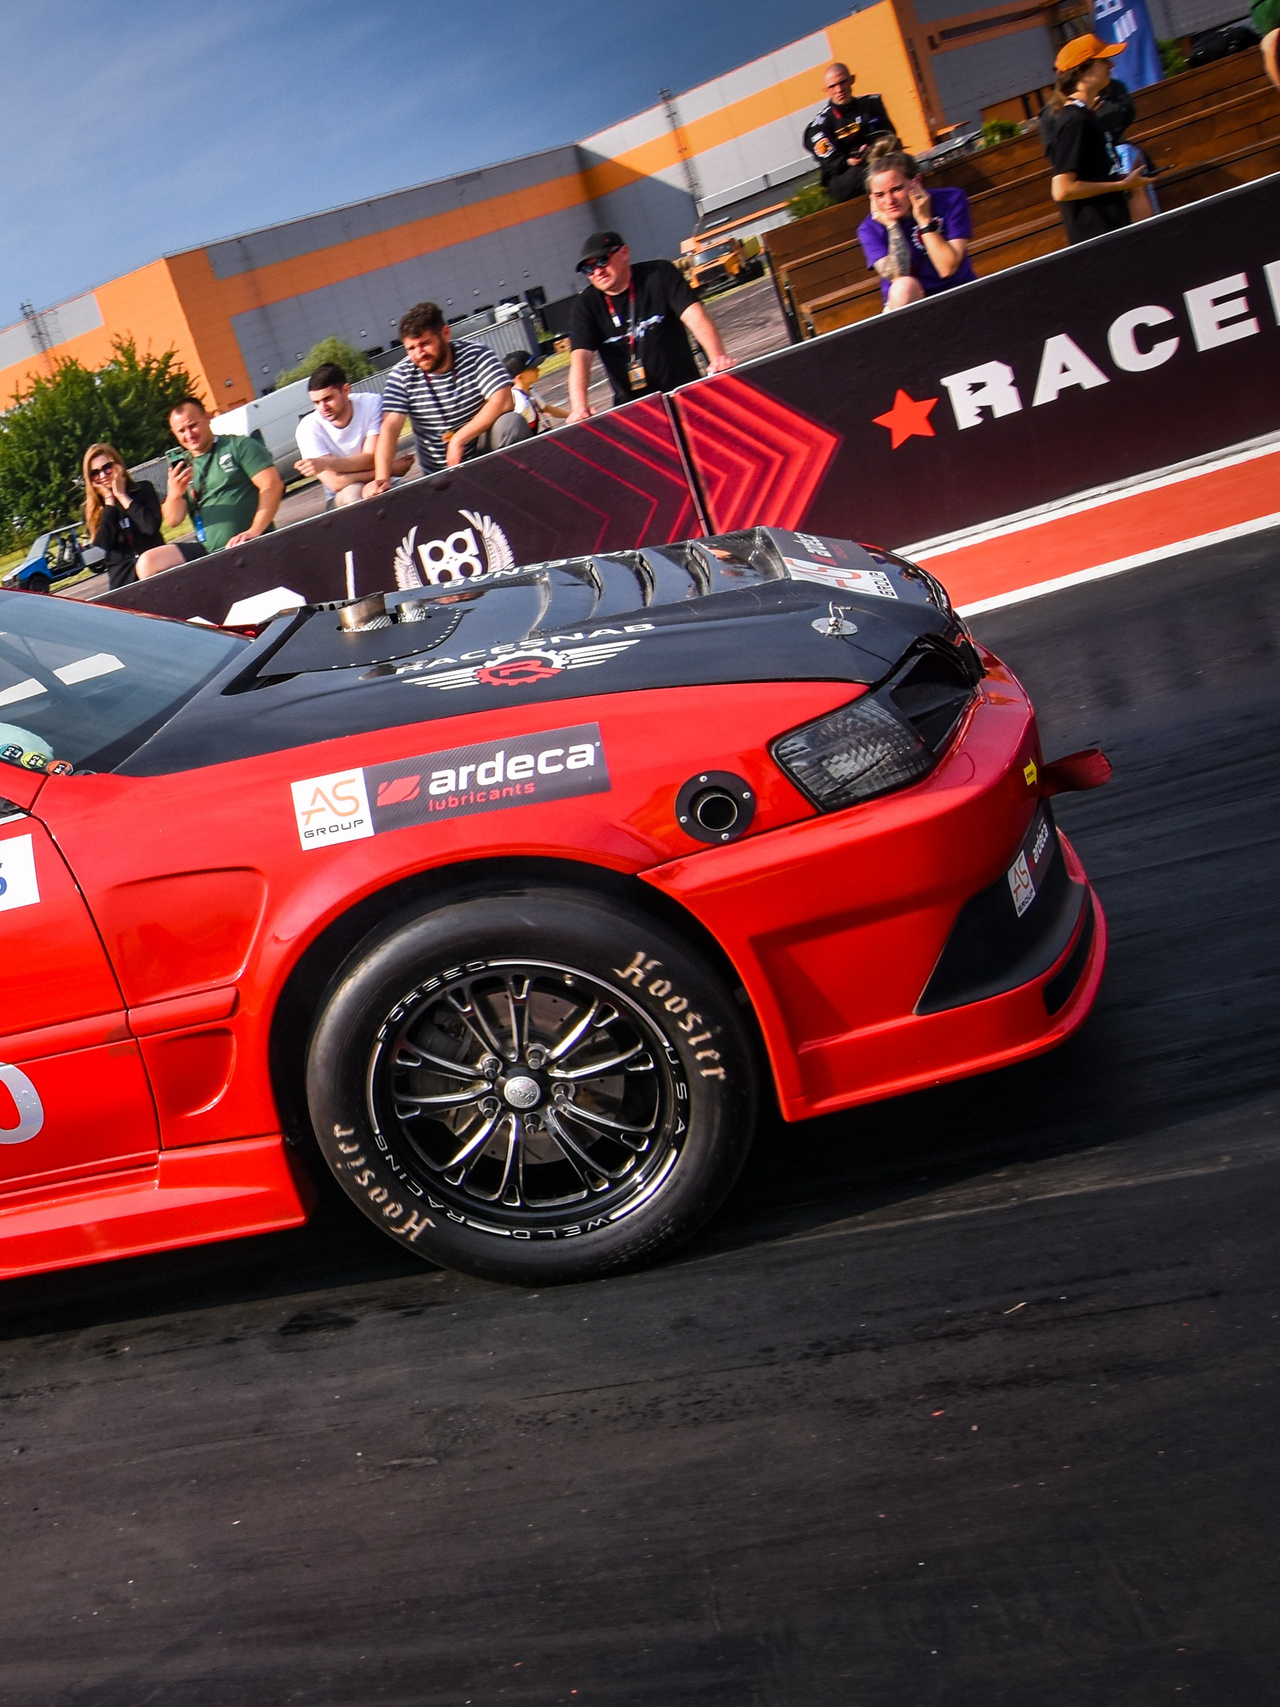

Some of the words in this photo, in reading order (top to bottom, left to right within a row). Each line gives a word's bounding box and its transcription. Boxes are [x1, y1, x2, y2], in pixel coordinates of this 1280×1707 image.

[940, 260, 1280, 430] RACE
[395, 623, 655, 675] RACESNAB
[429, 742, 596, 795] ardeca
[300, 778, 361, 826] AS
[428, 782, 536, 812] lubricants
[303, 818, 365, 840] GROUP
[377, 960, 487, 1041] FORGED
[374, 1134, 466, 1224] RACING
[512, 1217, 610, 1240] WELD
